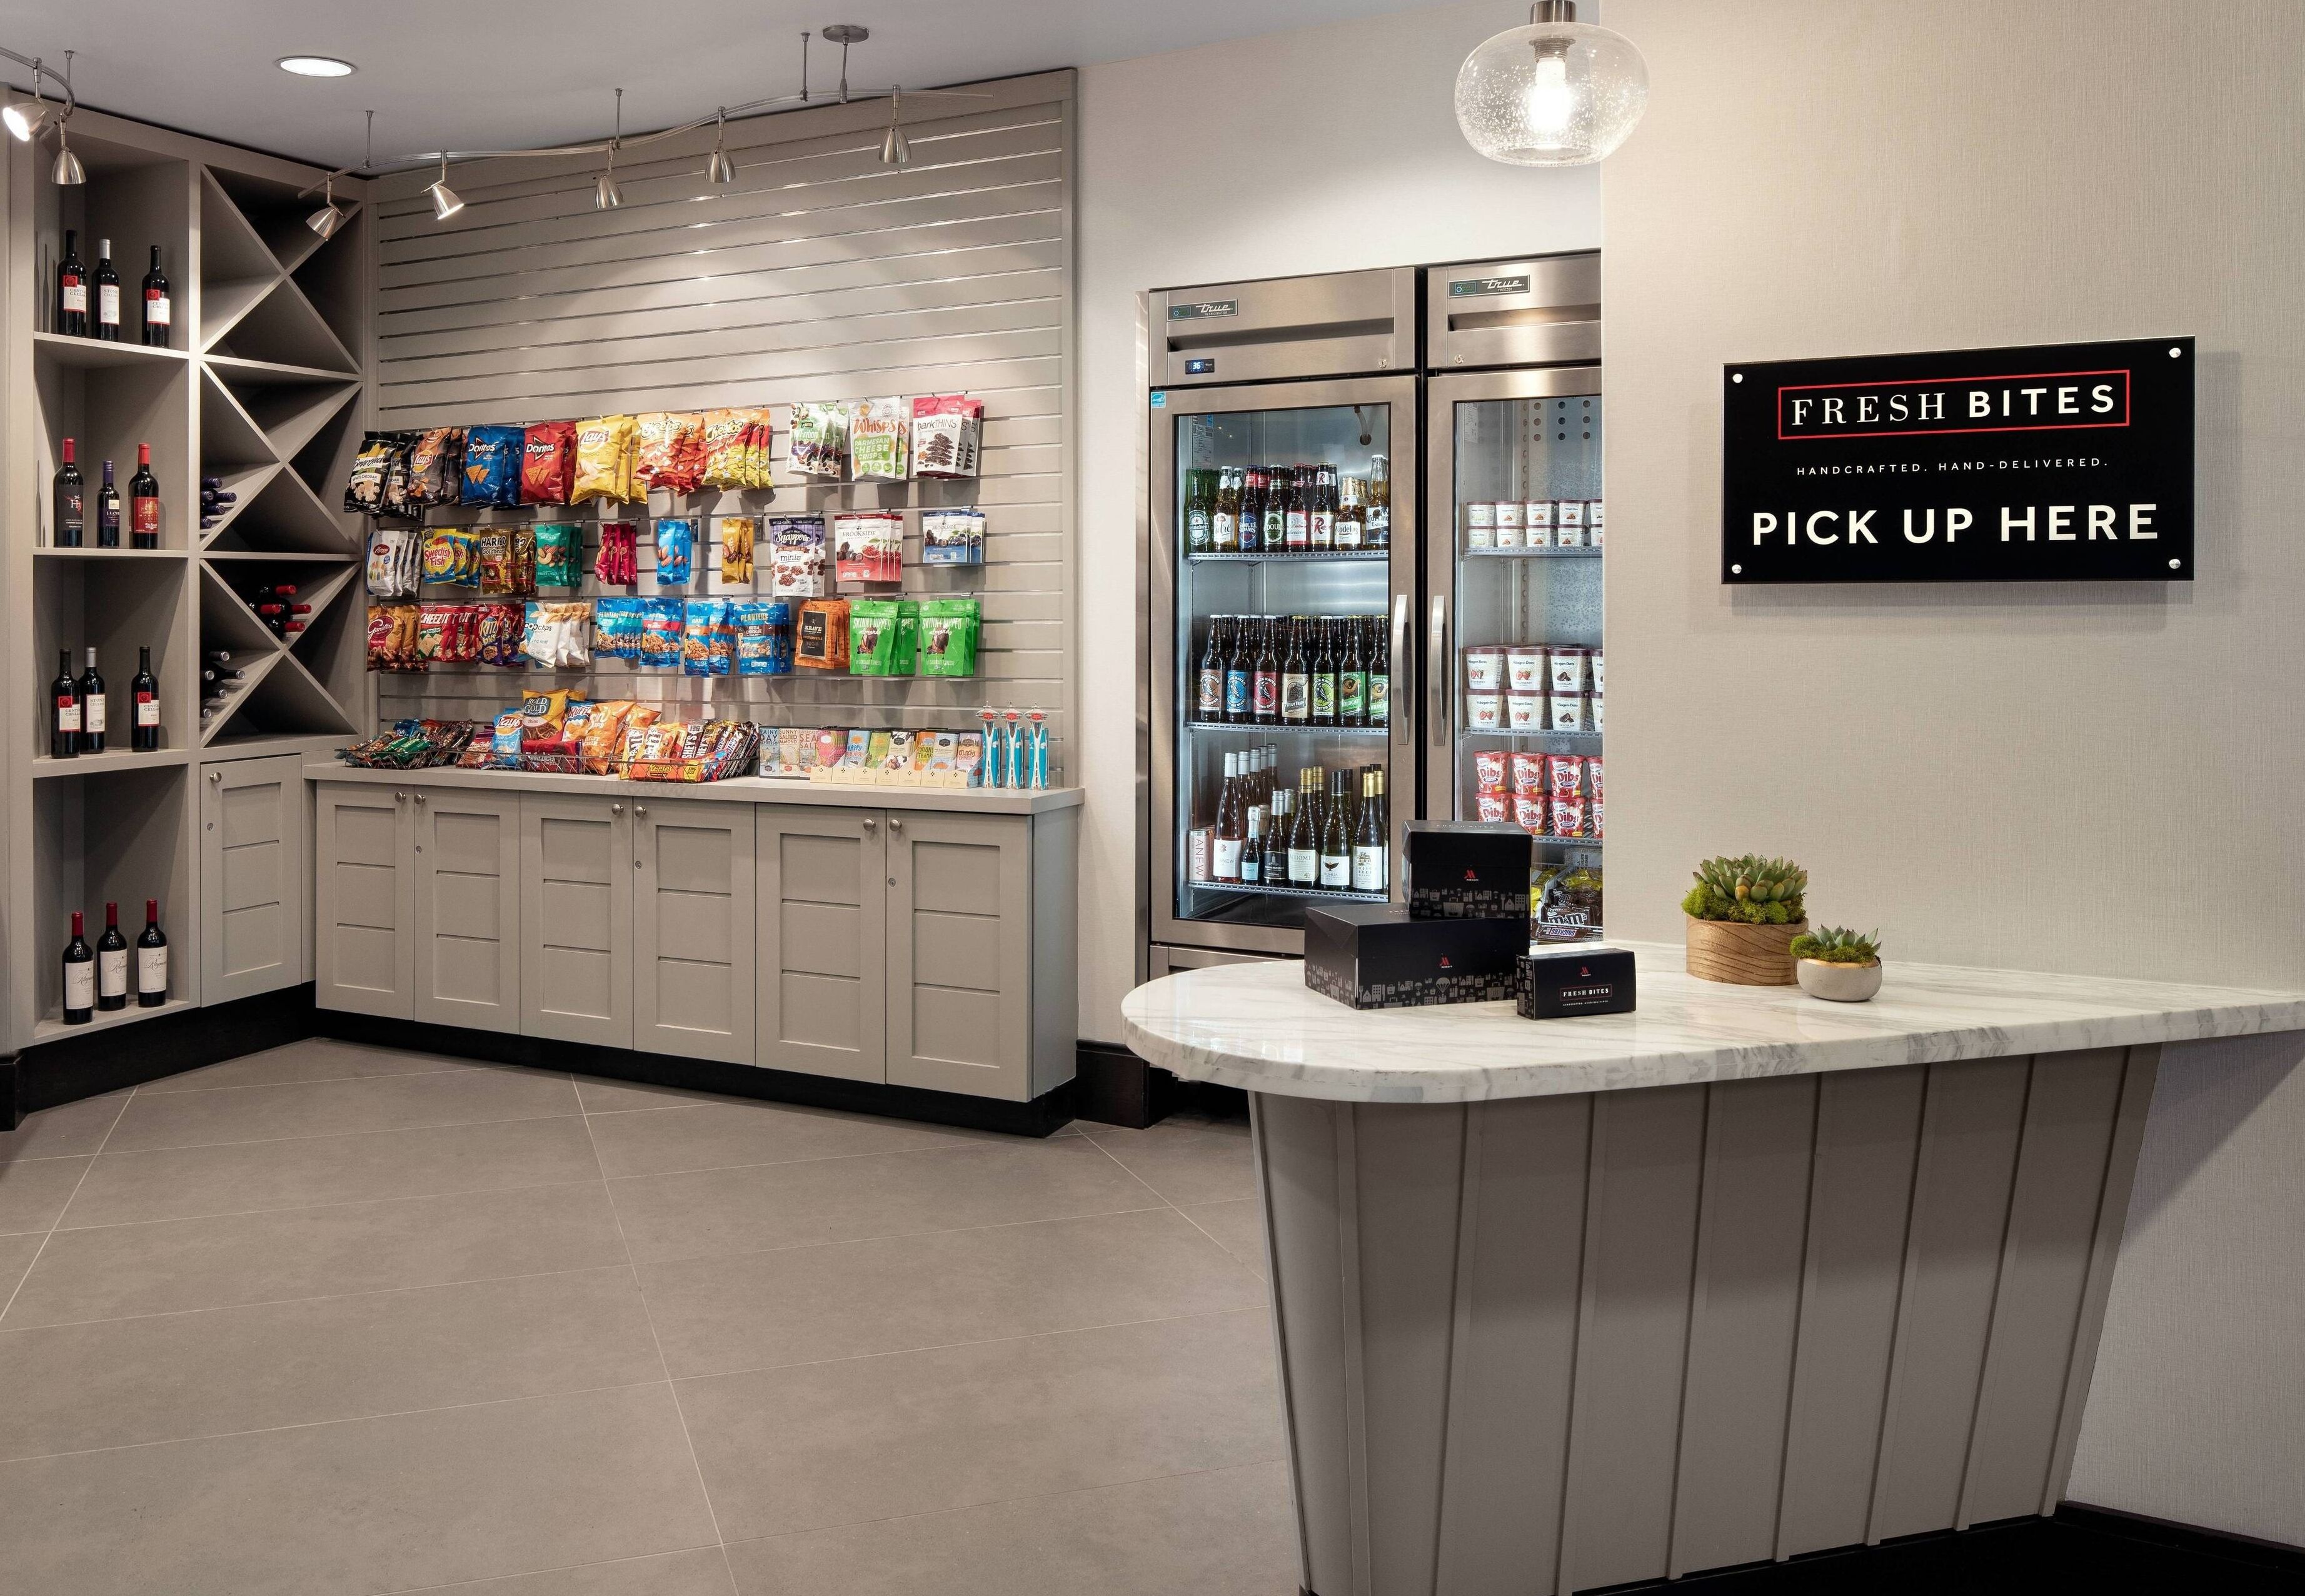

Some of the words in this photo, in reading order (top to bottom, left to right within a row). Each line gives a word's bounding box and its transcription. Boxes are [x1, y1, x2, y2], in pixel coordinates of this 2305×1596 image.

[1192, 361, 1202, 370] 36
[1792, 393, 1946, 426] FRESH
[1969, 384, 2115, 418] BITES
[468, 442, 496, 452] Doritos
[526, 443, 555, 453] Doritos
[855, 444, 889, 454] CHEESE
[1797, 463, 1928, 476] HANDCRAFTED.
[1939, 457, 2108, 471] HAND-DELIVERED.
[1753, 509, 1879, 546] PICK
[1903, 507, 1974, 544] UP
[2001, 503, 2159, 543] HERE
[481, 536, 507, 548] HARIBO
[424, 547, 452, 561] Swedish
[429, 557, 445, 566] Fish
[740, 613, 769, 622] PLANTERS
[480, 620, 498, 635] RITZ
[528, 697, 548, 705] ROLD
[524, 705, 547, 715] GOLD
[800, 733, 818, 743] SEA
[1517, 768, 1539, 779] Dibs
[1557, 770, 1579, 782] Dibs
[1519, 809, 1542, 821] Dibs
[1555, 811, 1578, 823] Dibs
[1195, 838, 1204, 876] ANEW
[1550, 928, 1577, 936] SNICKERS
